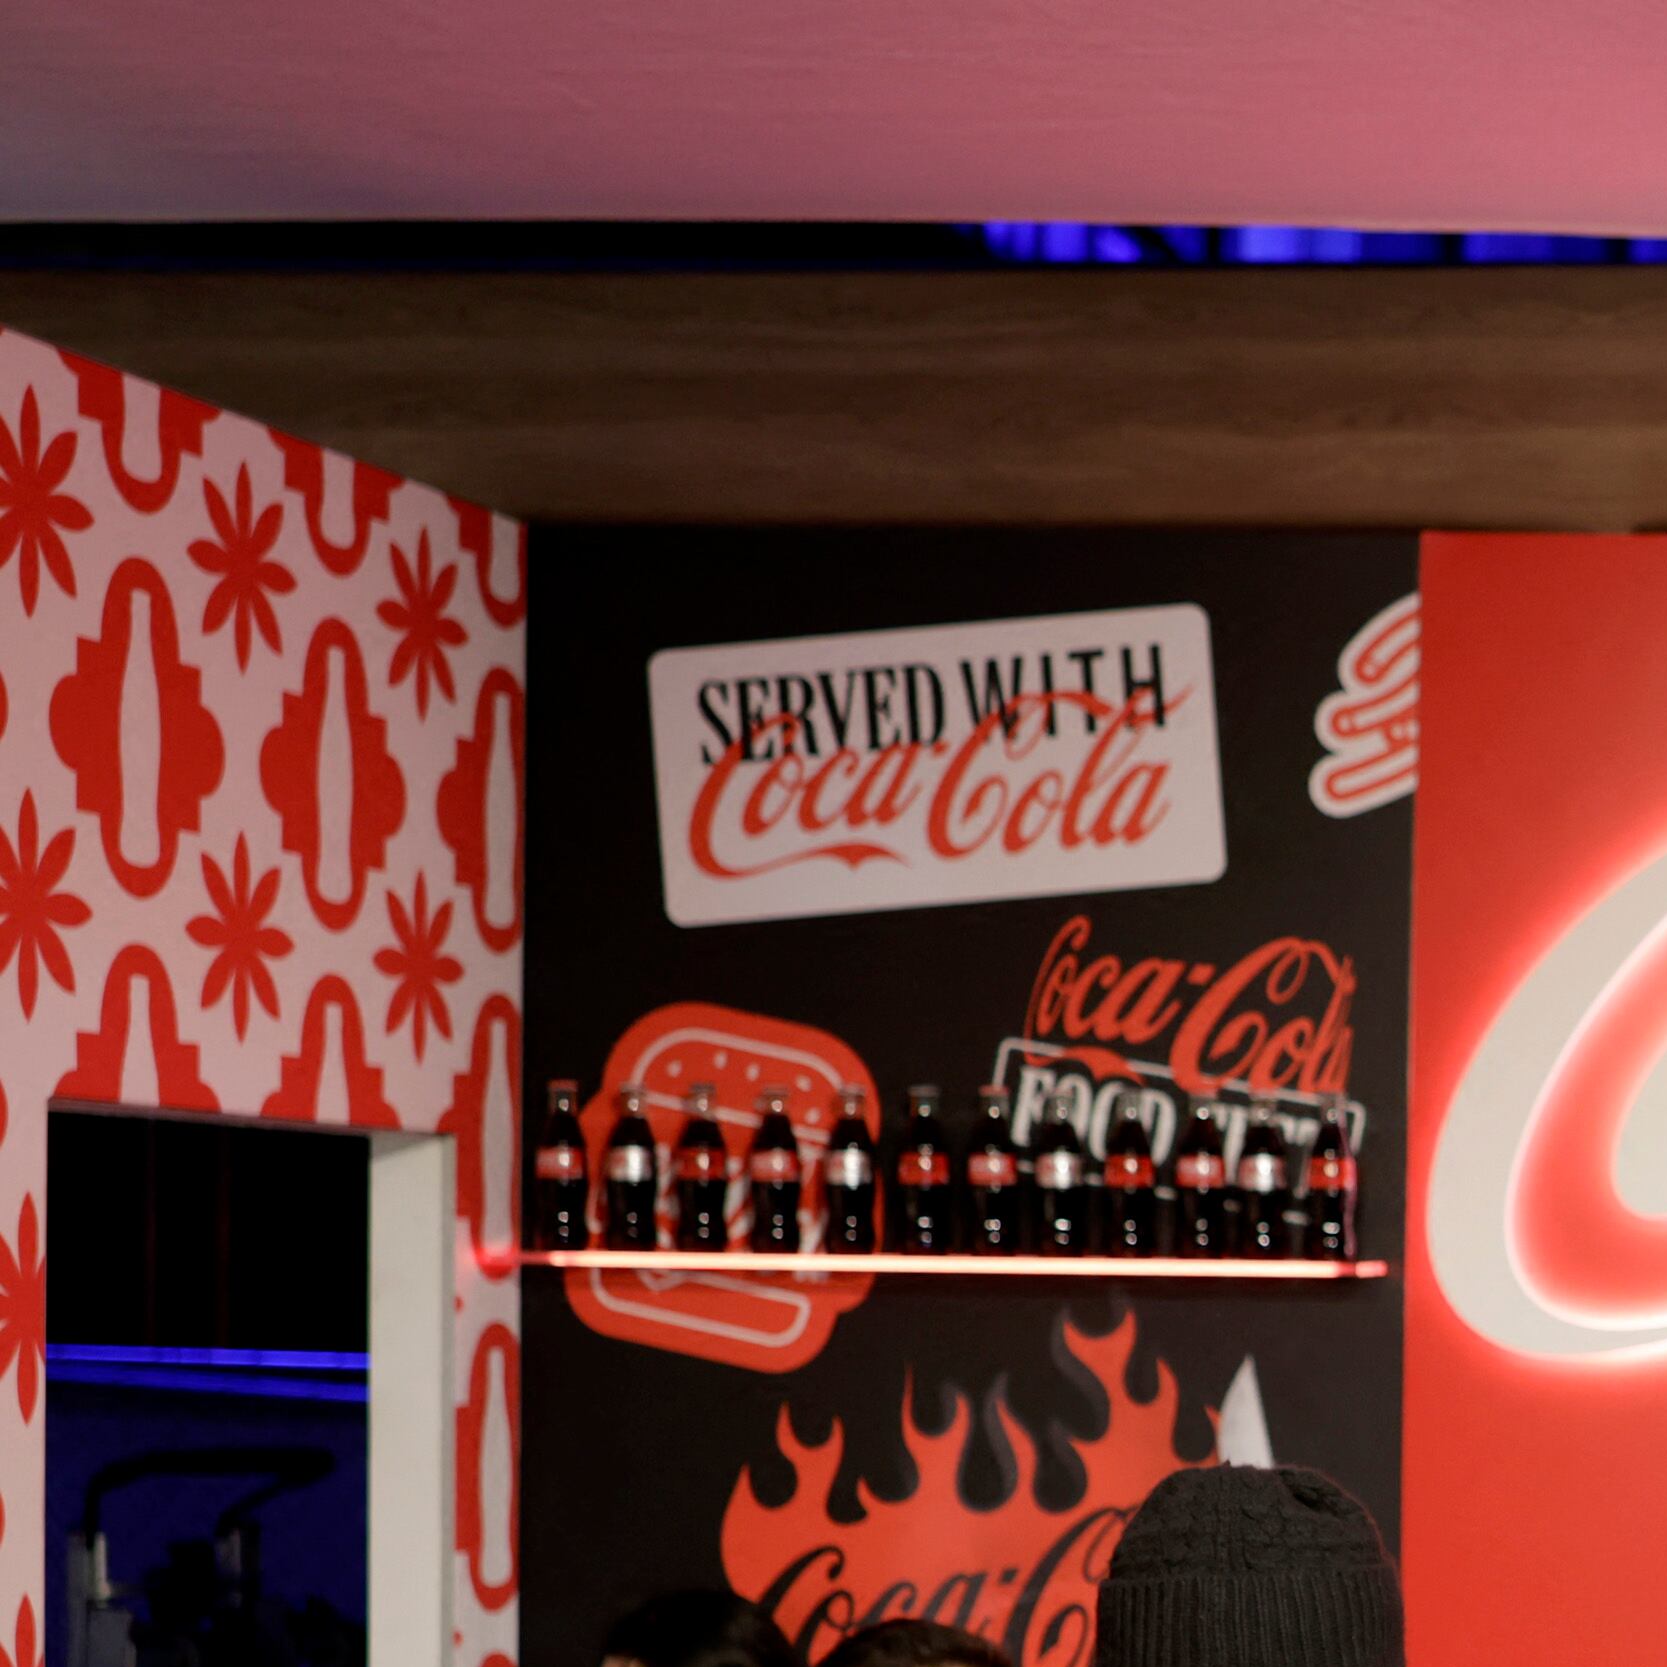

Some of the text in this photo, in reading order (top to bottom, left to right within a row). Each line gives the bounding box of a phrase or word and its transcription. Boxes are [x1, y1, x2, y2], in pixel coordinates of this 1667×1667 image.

[698, 643, 1167, 765] SERVED WITH
[689, 687, 1194, 880] Coca-Cola
